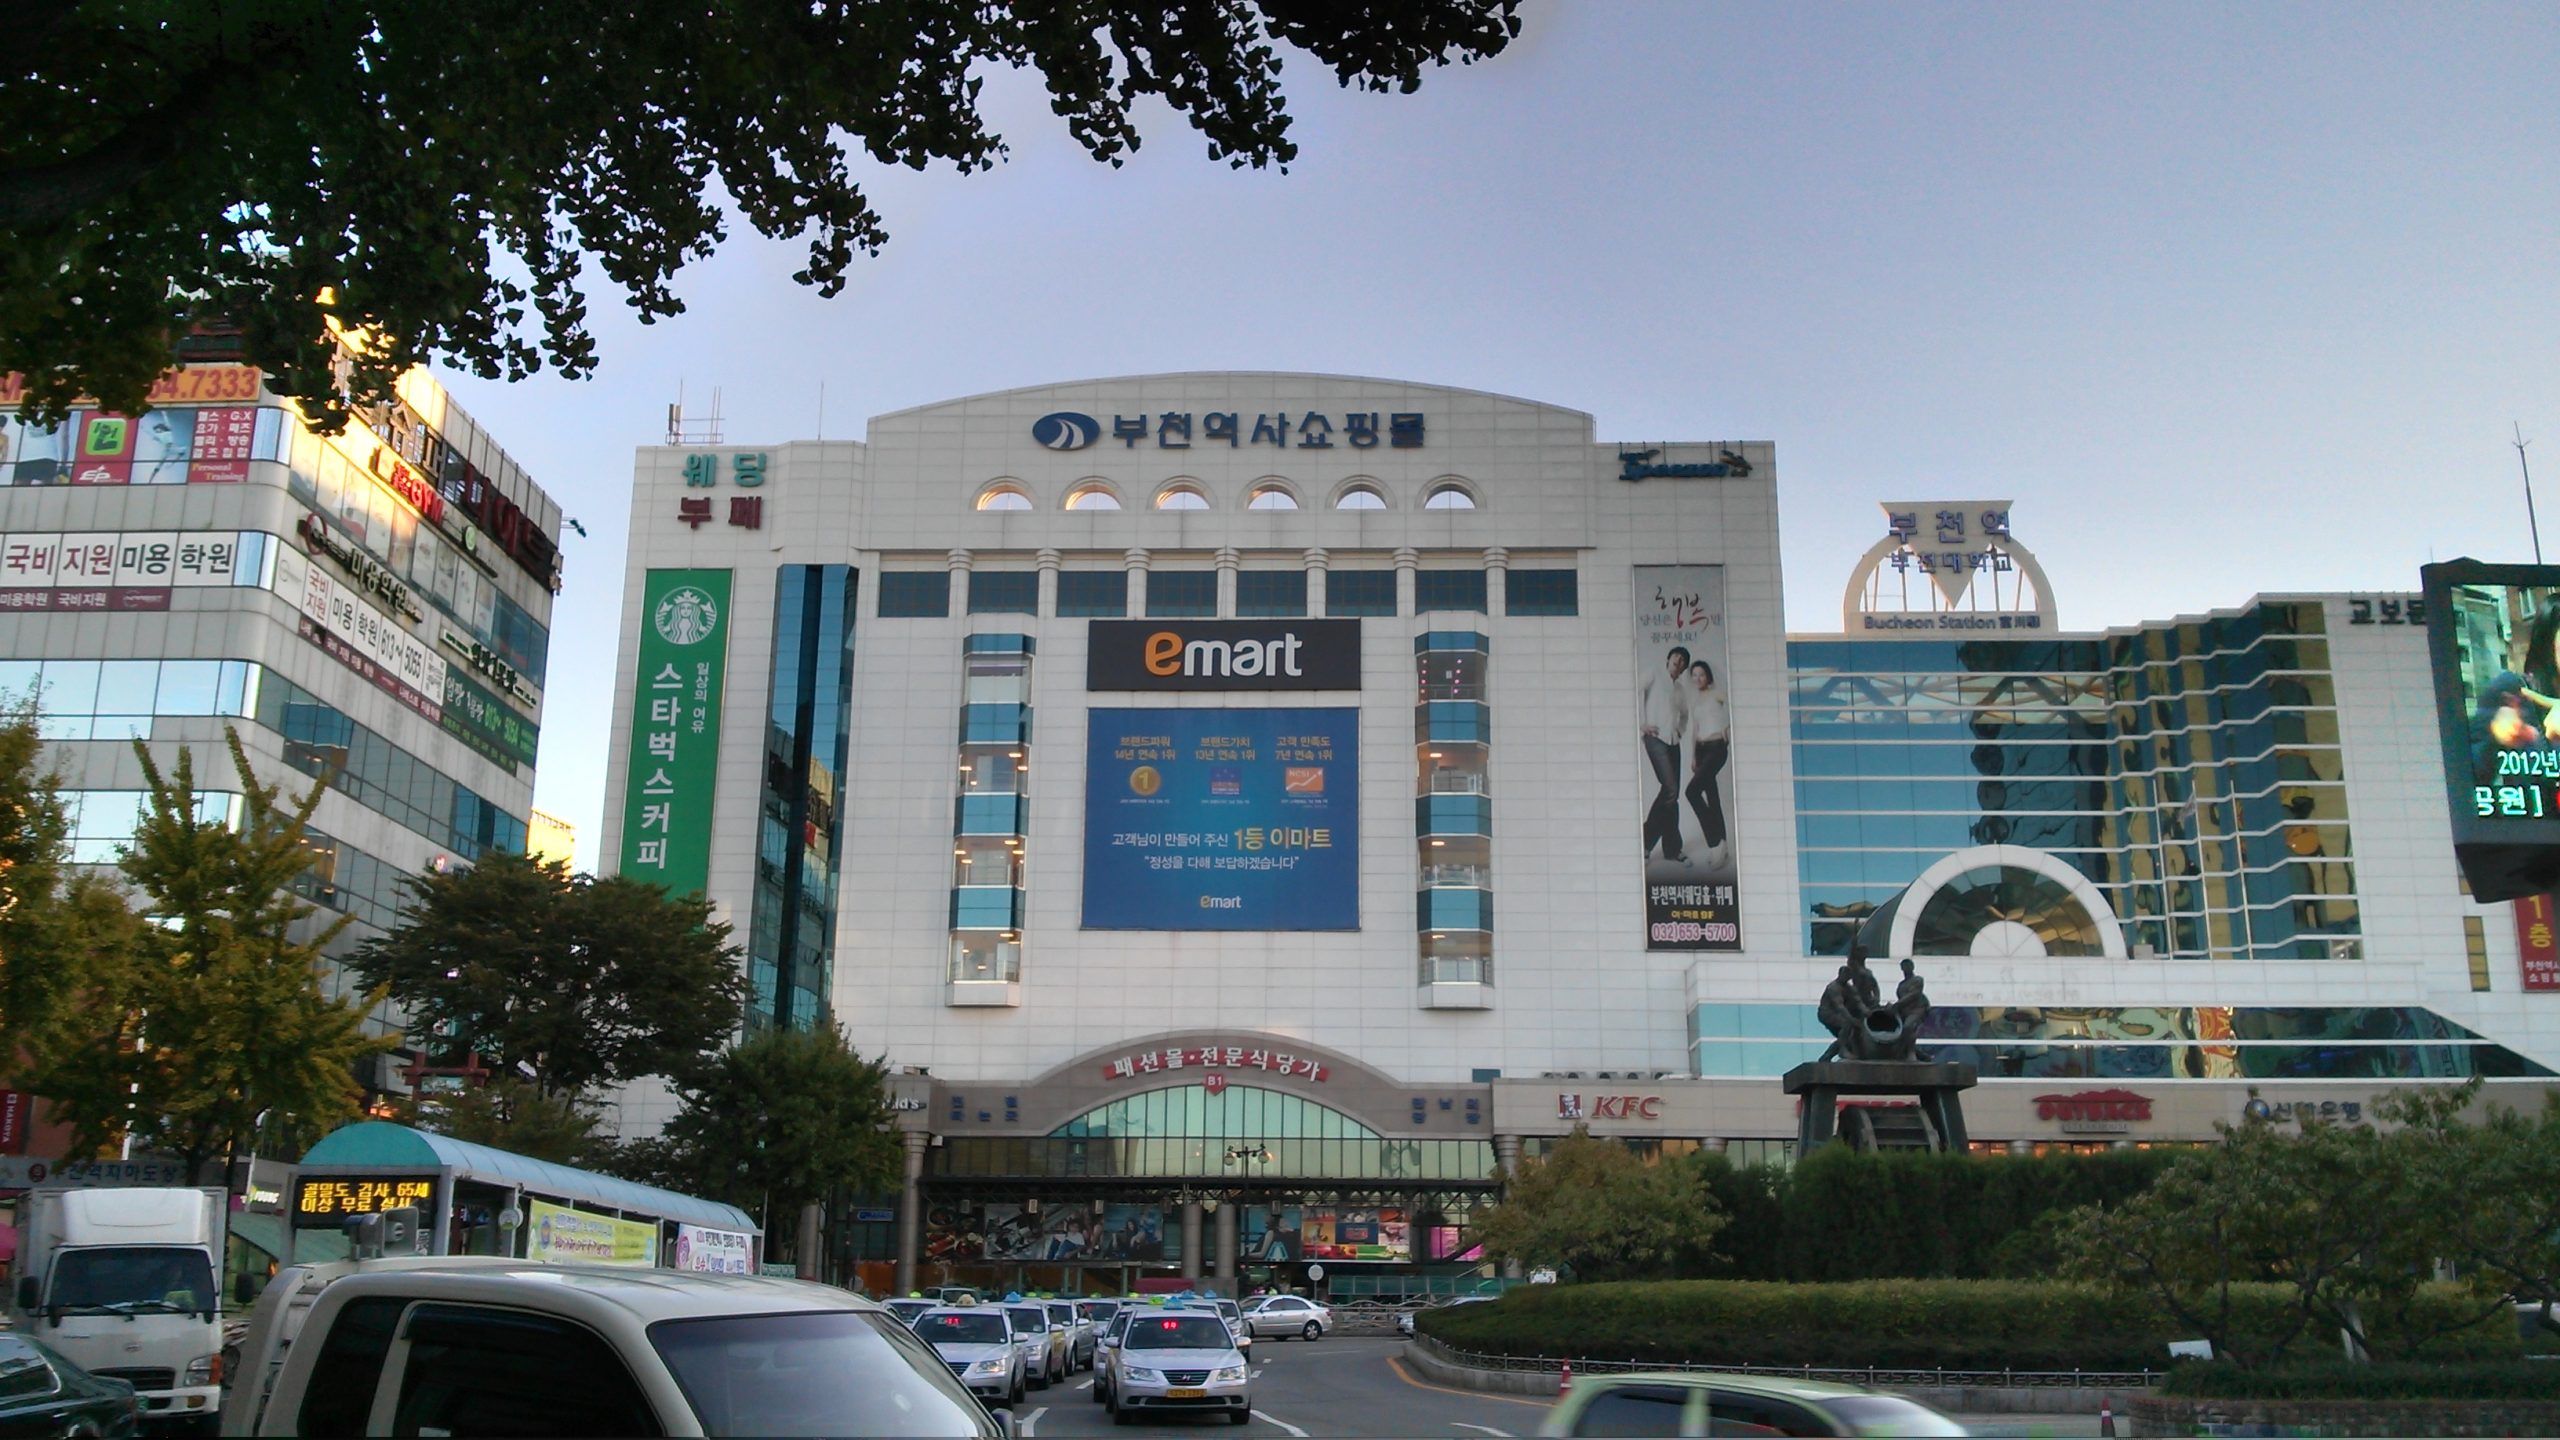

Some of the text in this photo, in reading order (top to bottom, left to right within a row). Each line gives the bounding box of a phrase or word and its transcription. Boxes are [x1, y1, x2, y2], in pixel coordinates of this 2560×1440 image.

[195, 423, 218, 434] 요가
[1113, 411, 1425, 449] 부천역사쇼핑몰
[191, 463, 231, 472] Personal
[206, 473, 245, 482] Training
[682, 452, 767, 488] 웨딩
[1889, 509, 2011, 545] 부천역
[6, 543, 232, 576] 국비 지원 미용 학원
[1891, 551, 2013, 574] 부천대학교
[309, 568, 330, 599] 국비
[352, 548, 407, 615] 미용학원
[307, 593, 327, 621] 지원
[1655, 585, 1709, 633] 행복
[2349, 599, 2427, 625] 교보문
[333, 596, 353, 631] 미용
[359, 612, 378, 648] 학원
[1864, 615, 1935, 630] Bucheon
[1939, 615, 1996, 630] Station
[1650, 631, 1698, 645] 꿈꾸세요!
[1144, 630, 1303, 677] emart
[691, 661, 710, 734] 일상의 여유
[1119, 736, 1171, 747] 브랜드파워
[1200, 736, 1251, 747] 브랜드가치
[1276, 736, 1332, 747] 고객 만족도
[1138, 749, 1156, 761] 연속
[1162, 749, 1176, 761] 1위
[1219, 749, 1237, 761] 연속
[1241, 749, 1256, 761] 1위
[1275, 749, 1333, 761] 7년 연속 1위
[2498, 750, 2560, 777] 2012년
[636, 663, 684, 870] 스타벅스커피
[1138, 771, 1149, 790] 1
[1111, 827, 1332, 851] 고객님이 만들어 주신 1등 이마트
[1187, 855, 1211, 870] 다해
[1200, 895, 1242, 909] emart
[1651, 921, 1737, 943] 032)653-5700
[1113, 1046, 1321, 1083] 패션몰·전문식당가
[1207, 1075, 1223, 1086] B1
[1591, 1095, 1663, 1120] KFC
[2036, 1101, 2152, 1121] OUTBACK
[2065, 1123, 2129, 1133] STEAKHOUSE
[303, 1182, 429, 1198] 골밀도 검사 65세
[301, 1197, 333, 1213] 이상
[341, 1197, 372, 1213] 무료
